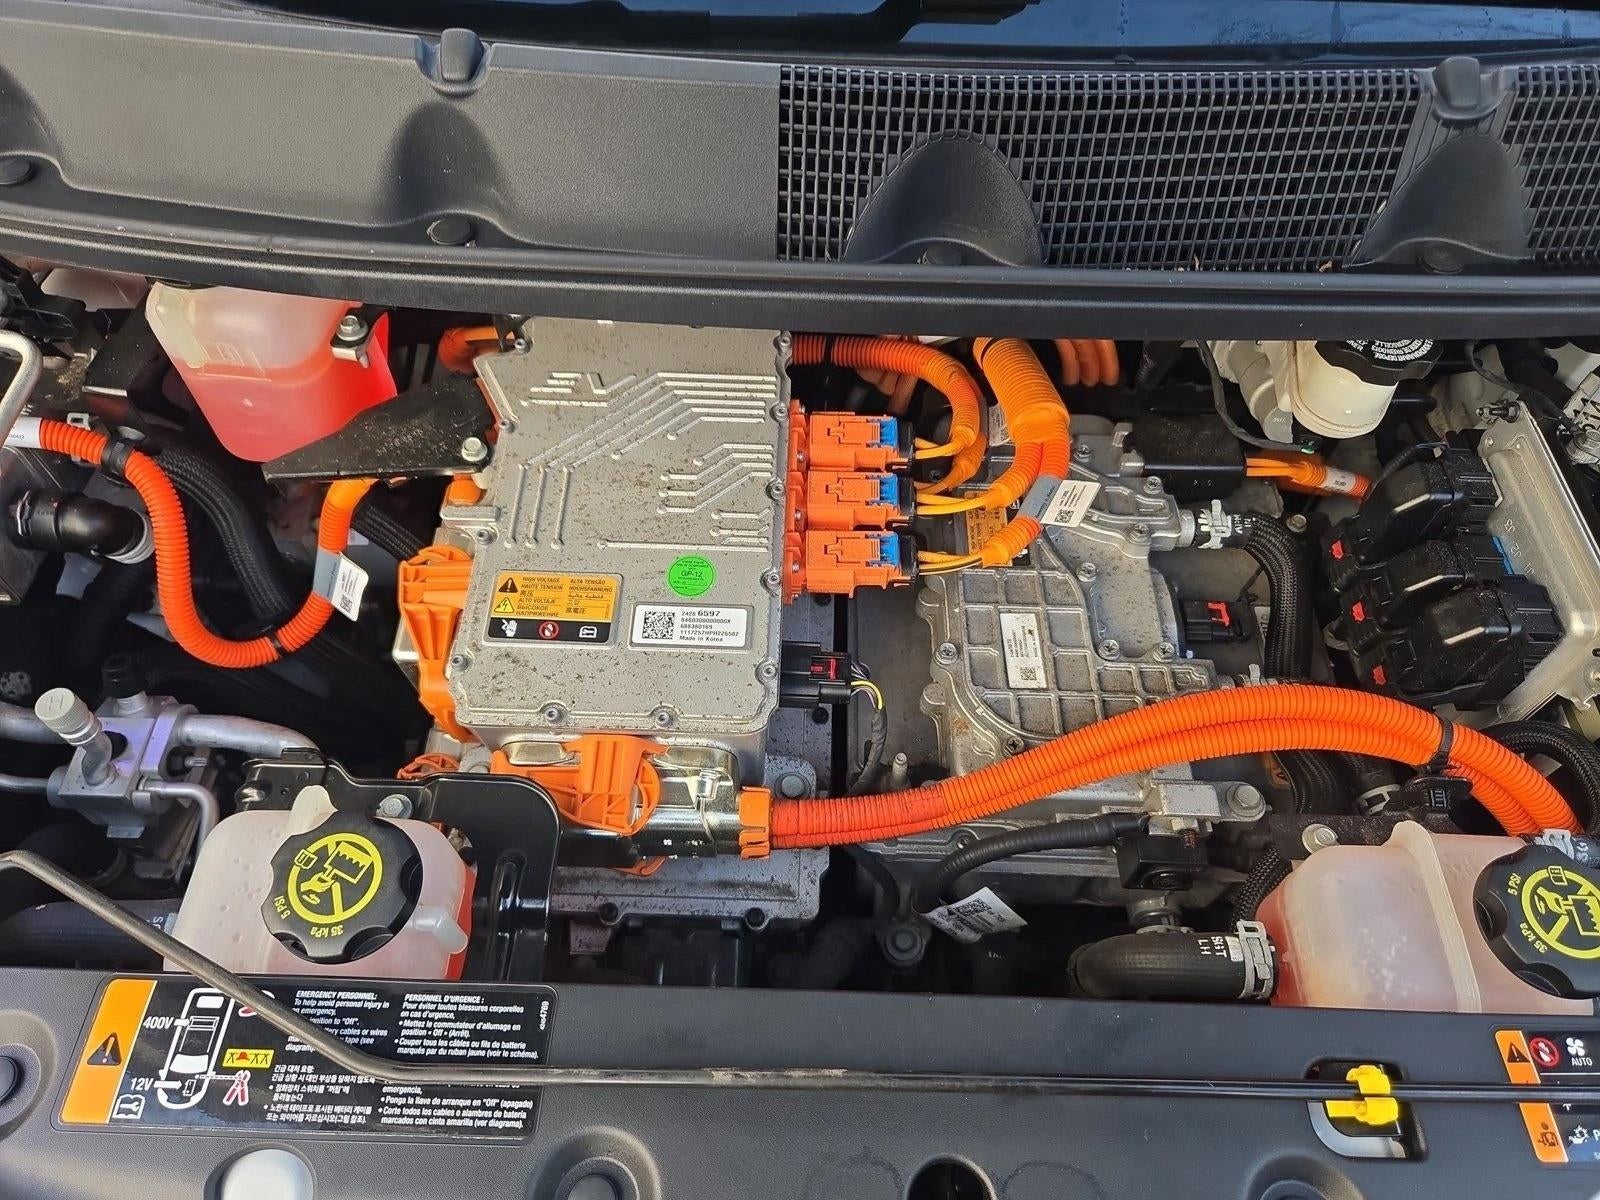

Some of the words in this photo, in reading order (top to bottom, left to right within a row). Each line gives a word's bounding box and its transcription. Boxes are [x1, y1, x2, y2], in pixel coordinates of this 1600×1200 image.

[1508, 873, 1521, 889] PSI
[274, 895, 286, 912] PSI
[280, 910, 290, 920] 5
[310, 926, 329, 939] kPa
[330, 924, 344, 936] 35
[1520, 923, 1536, 941] kPa
[1534, 940, 1548, 953] 35
[296, 990, 337, 998] EMERGENCY
[337, 992, 377, 1000] PERSONNEL:
[405, 994, 442, 1003] PERSONNEL
[444, 995, 481, 1003] D'URGENCE
[302, 999, 317, 1007] help
[335, 1000, 362, 1008] personal
[363, 1001, 382, 1009] injury
[418, 1002, 436, 1010] éviter
[438, 1003, 457, 1011] toutes
[458, 1004, 488, 1012] blessures
[489, 1004, 524, 1013] corporelles
[301, 1008, 336, 1016] emergency,
[422, 1011, 455, 1019] d'urgence,
[143, 1016, 174, 1029] 400V
[476, 1022, 511, 1032] d'allumage
[401, 1029, 426, 1037] position
[399, 1038, 421, 1048] Couper
[449, 1039, 470, 1047] câbles
[501, 1041, 526, 1049] batterie
[397, 1047, 425, 1055] marqués
[467, 1049, 486, 1058] jaune
[487, 1049, 501, 1058] (voir
[1571, 1058, 1592, 1066] AUTO
[131, 1077, 153, 1090] 12V
[382, 1086, 422, 1095] emergencia,
[385, 1096, 406, 1105] Ponga
[442, 1099, 471, 1107] arranque
[501, 1099, 533, 1109] (apagado)
[383, 1107, 401, 1115] Corte
[402, 1107, 420, 1116] todos
[433, 1108, 455, 1116] cables
[462, 1109, 492, 1118] alambres
[493, 1110, 502, 1118] de
[381, 1116, 414, 1124] marcados
[428, 1117, 445, 1125] cinta
[446, 1118, 473, 1126] amarilla
[475, 1118, 488, 1128] (ver
[489, 1118, 523, 1128] diagrama).
